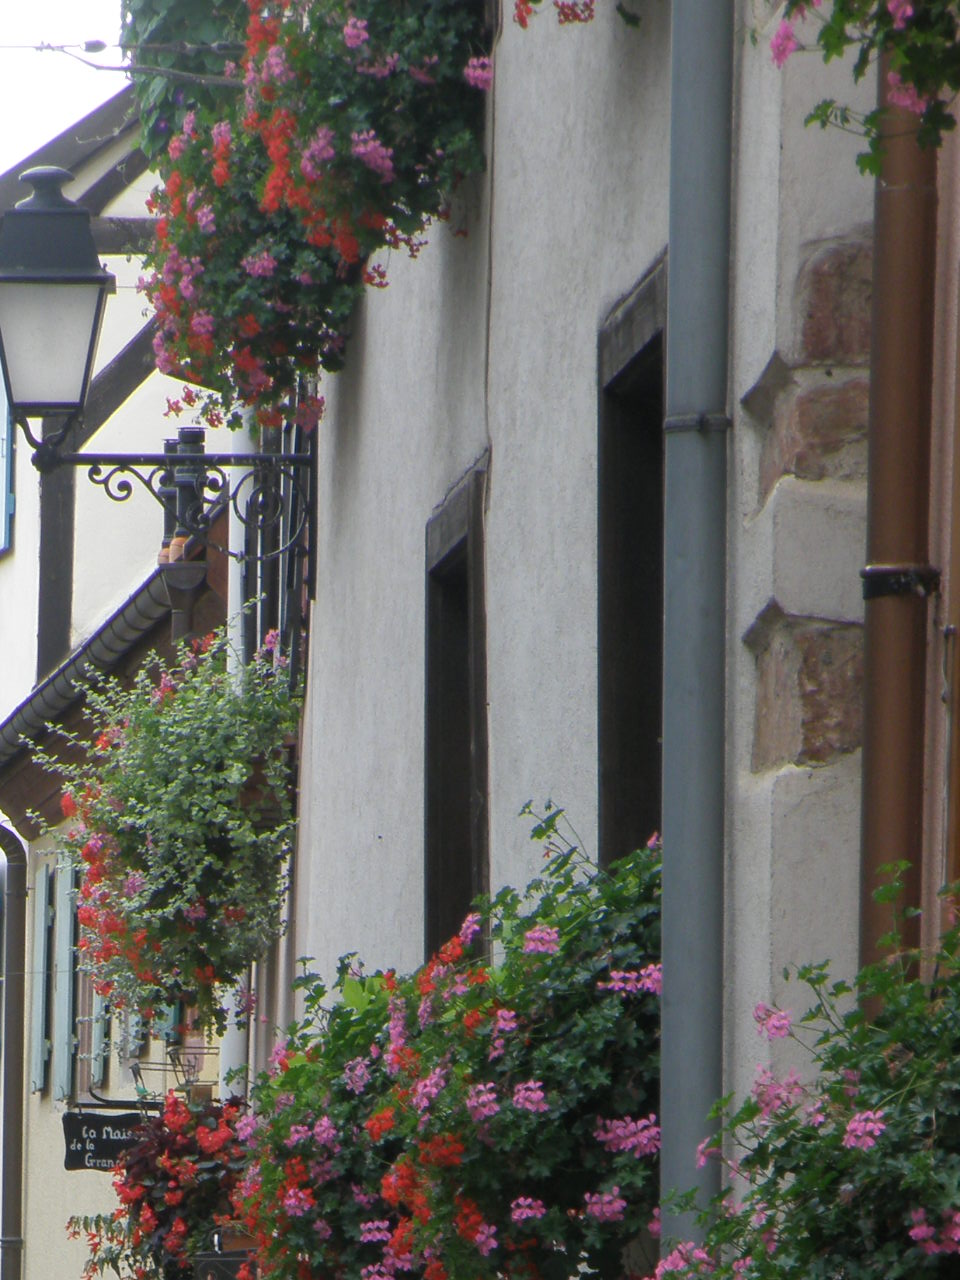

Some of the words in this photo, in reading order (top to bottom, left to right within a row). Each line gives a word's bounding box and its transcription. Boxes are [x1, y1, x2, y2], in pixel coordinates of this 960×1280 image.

[102, 1126, 134, 1140] Mais
[69, 1138, 83, 1151] de
[85, 1138, 95, 1151] la
